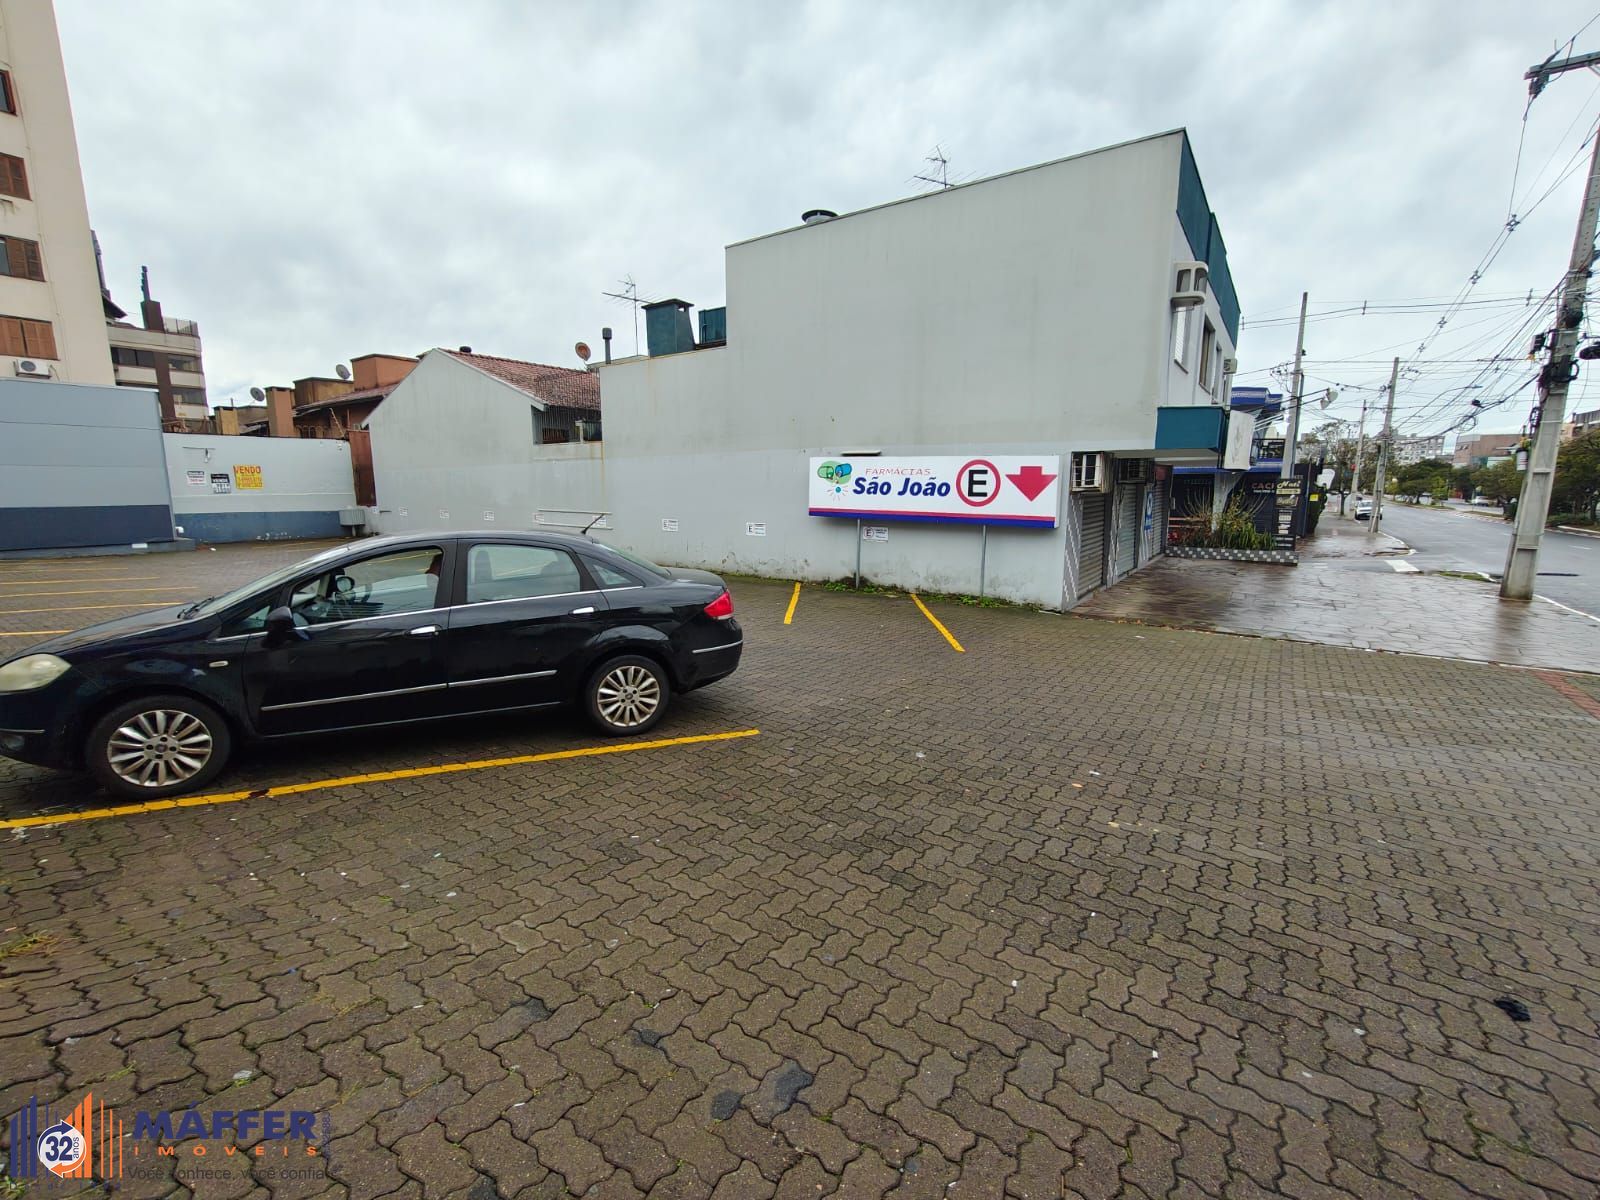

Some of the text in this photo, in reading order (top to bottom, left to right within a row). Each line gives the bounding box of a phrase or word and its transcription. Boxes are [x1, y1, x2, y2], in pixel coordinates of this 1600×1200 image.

[233, 466, 262, 474] VENDO
[852, 476, 951, 497] São João
[967, 469, 988, 497] E
